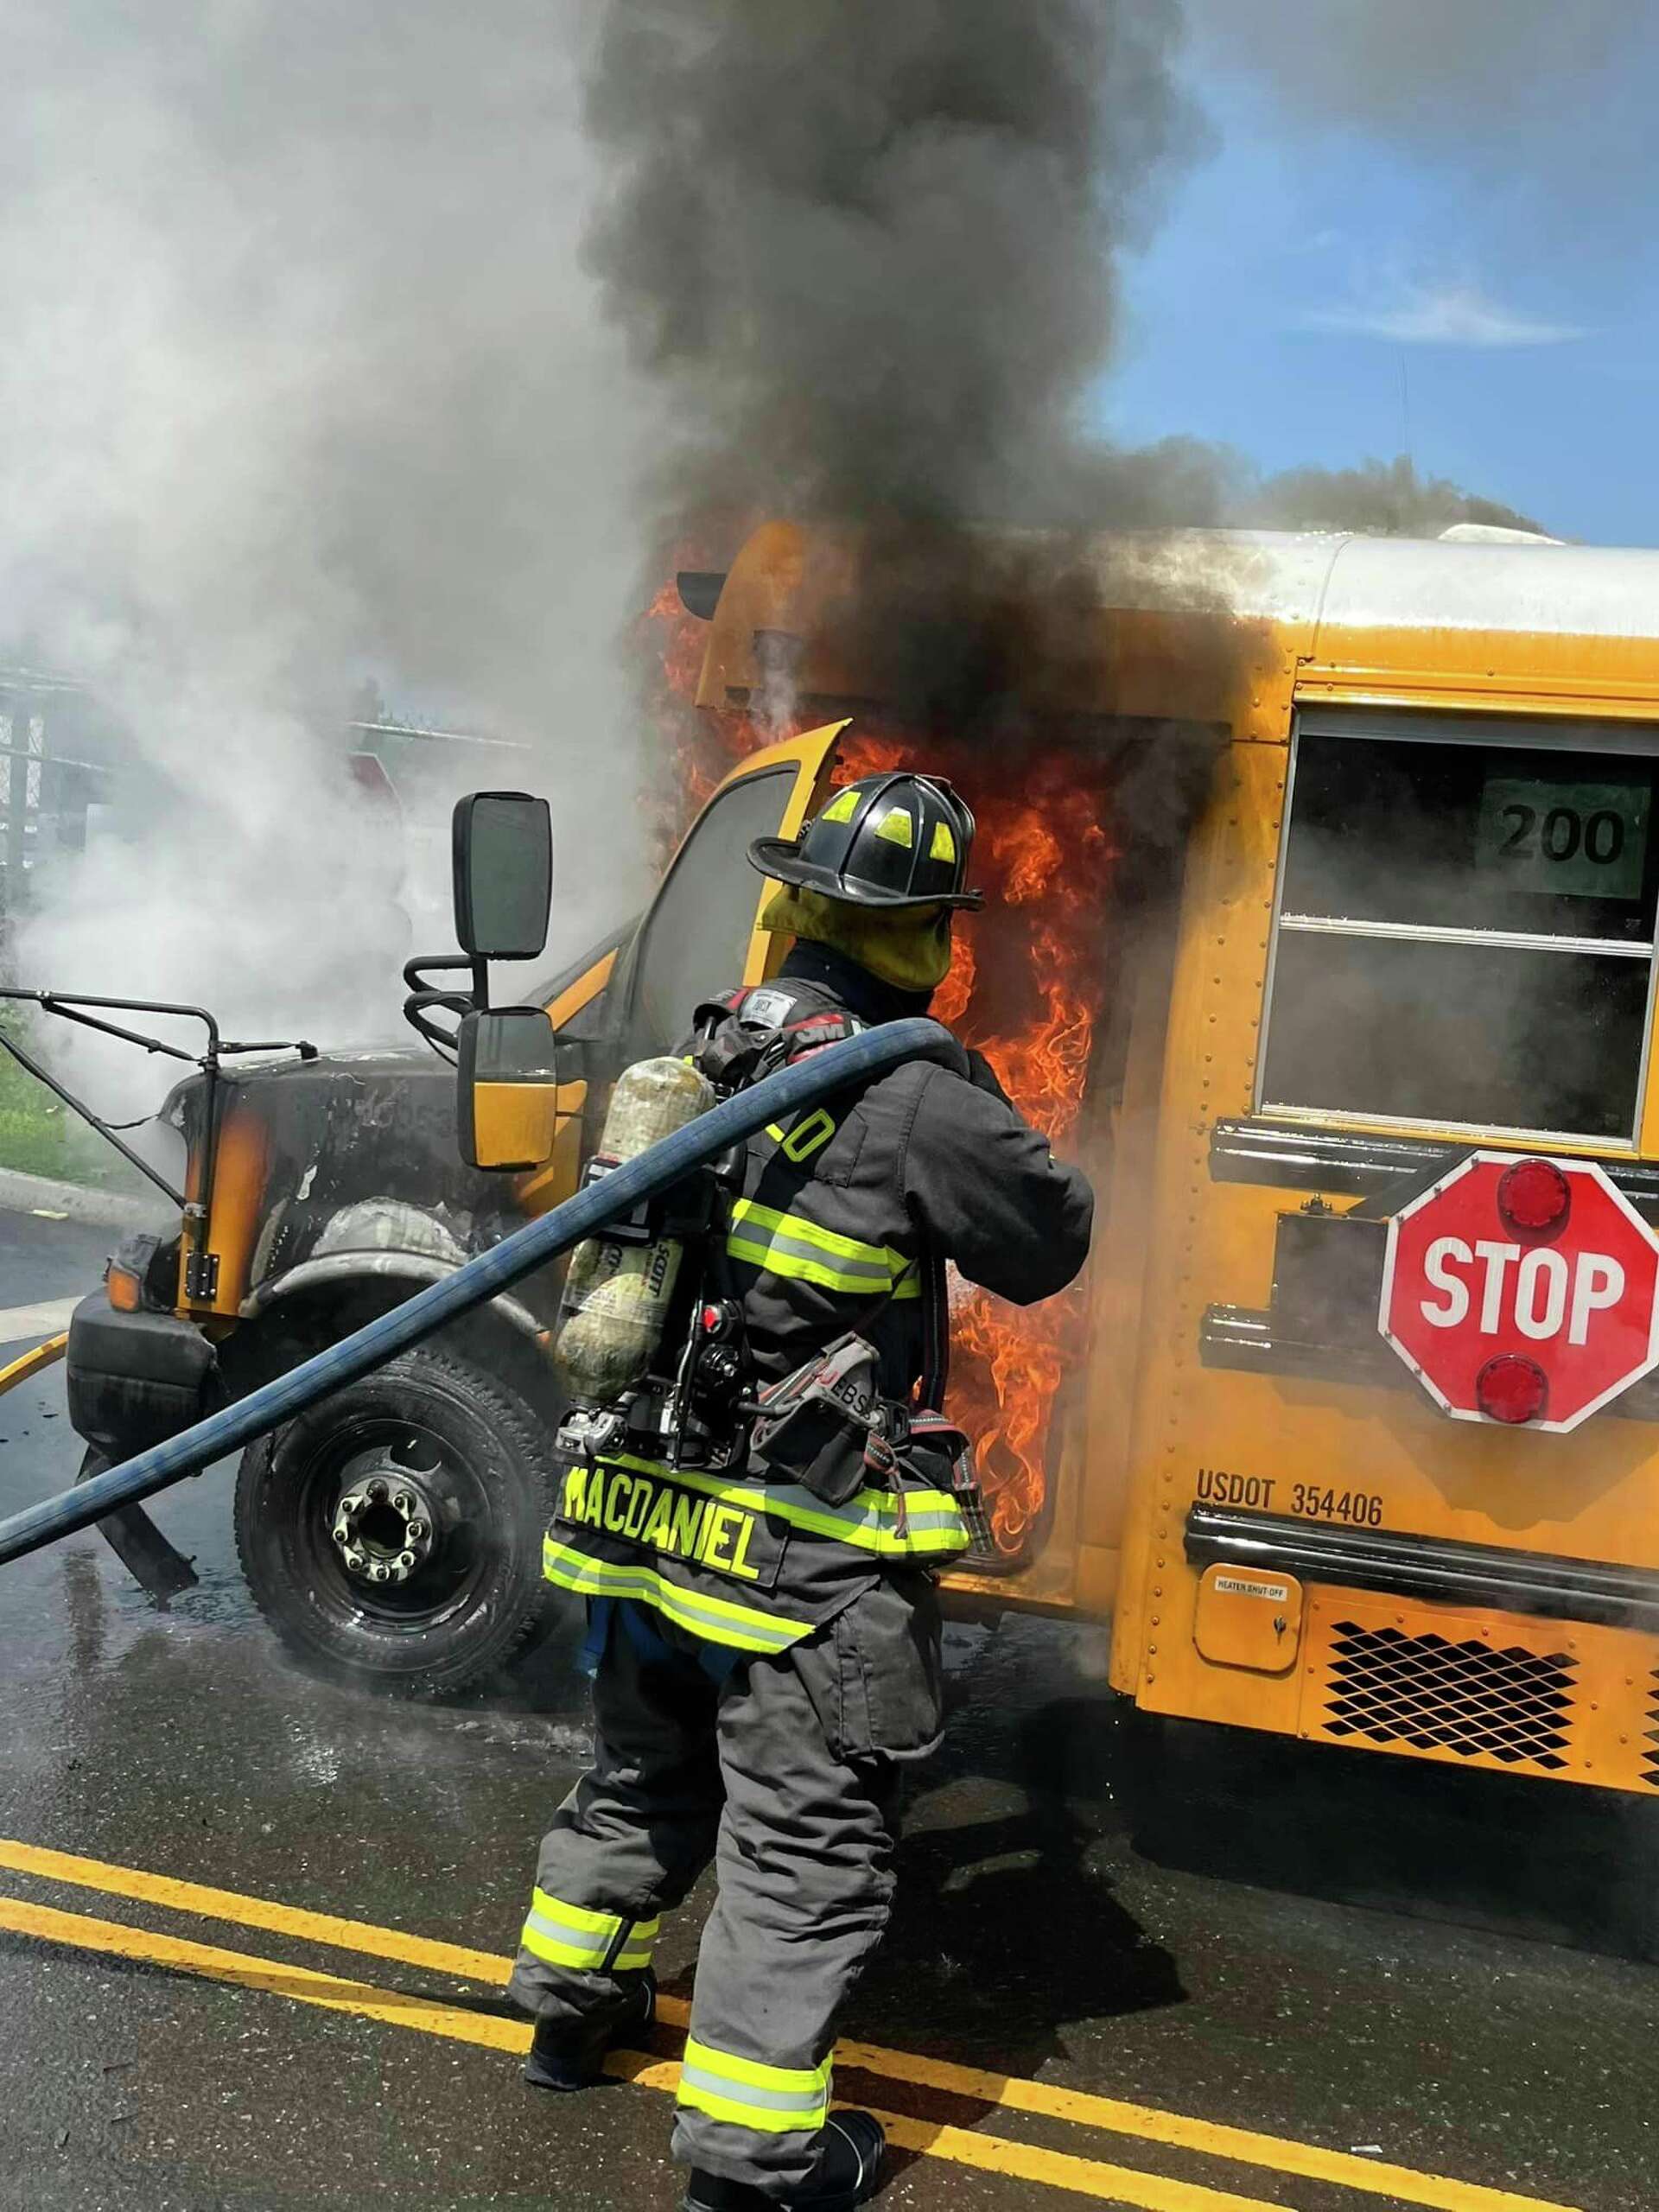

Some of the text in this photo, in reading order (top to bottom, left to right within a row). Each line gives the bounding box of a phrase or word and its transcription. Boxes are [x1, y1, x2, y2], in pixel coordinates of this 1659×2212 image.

[1497, 804, 1625, 864] 200
[1420, 1236, 1625, 1346] STOP
[564, 1466, 760, 1580] MACDANIEL
[1197, 1469, 1383, 1526] USDOT 354406
[1217, 1580, 1246, 1592] HEATER
